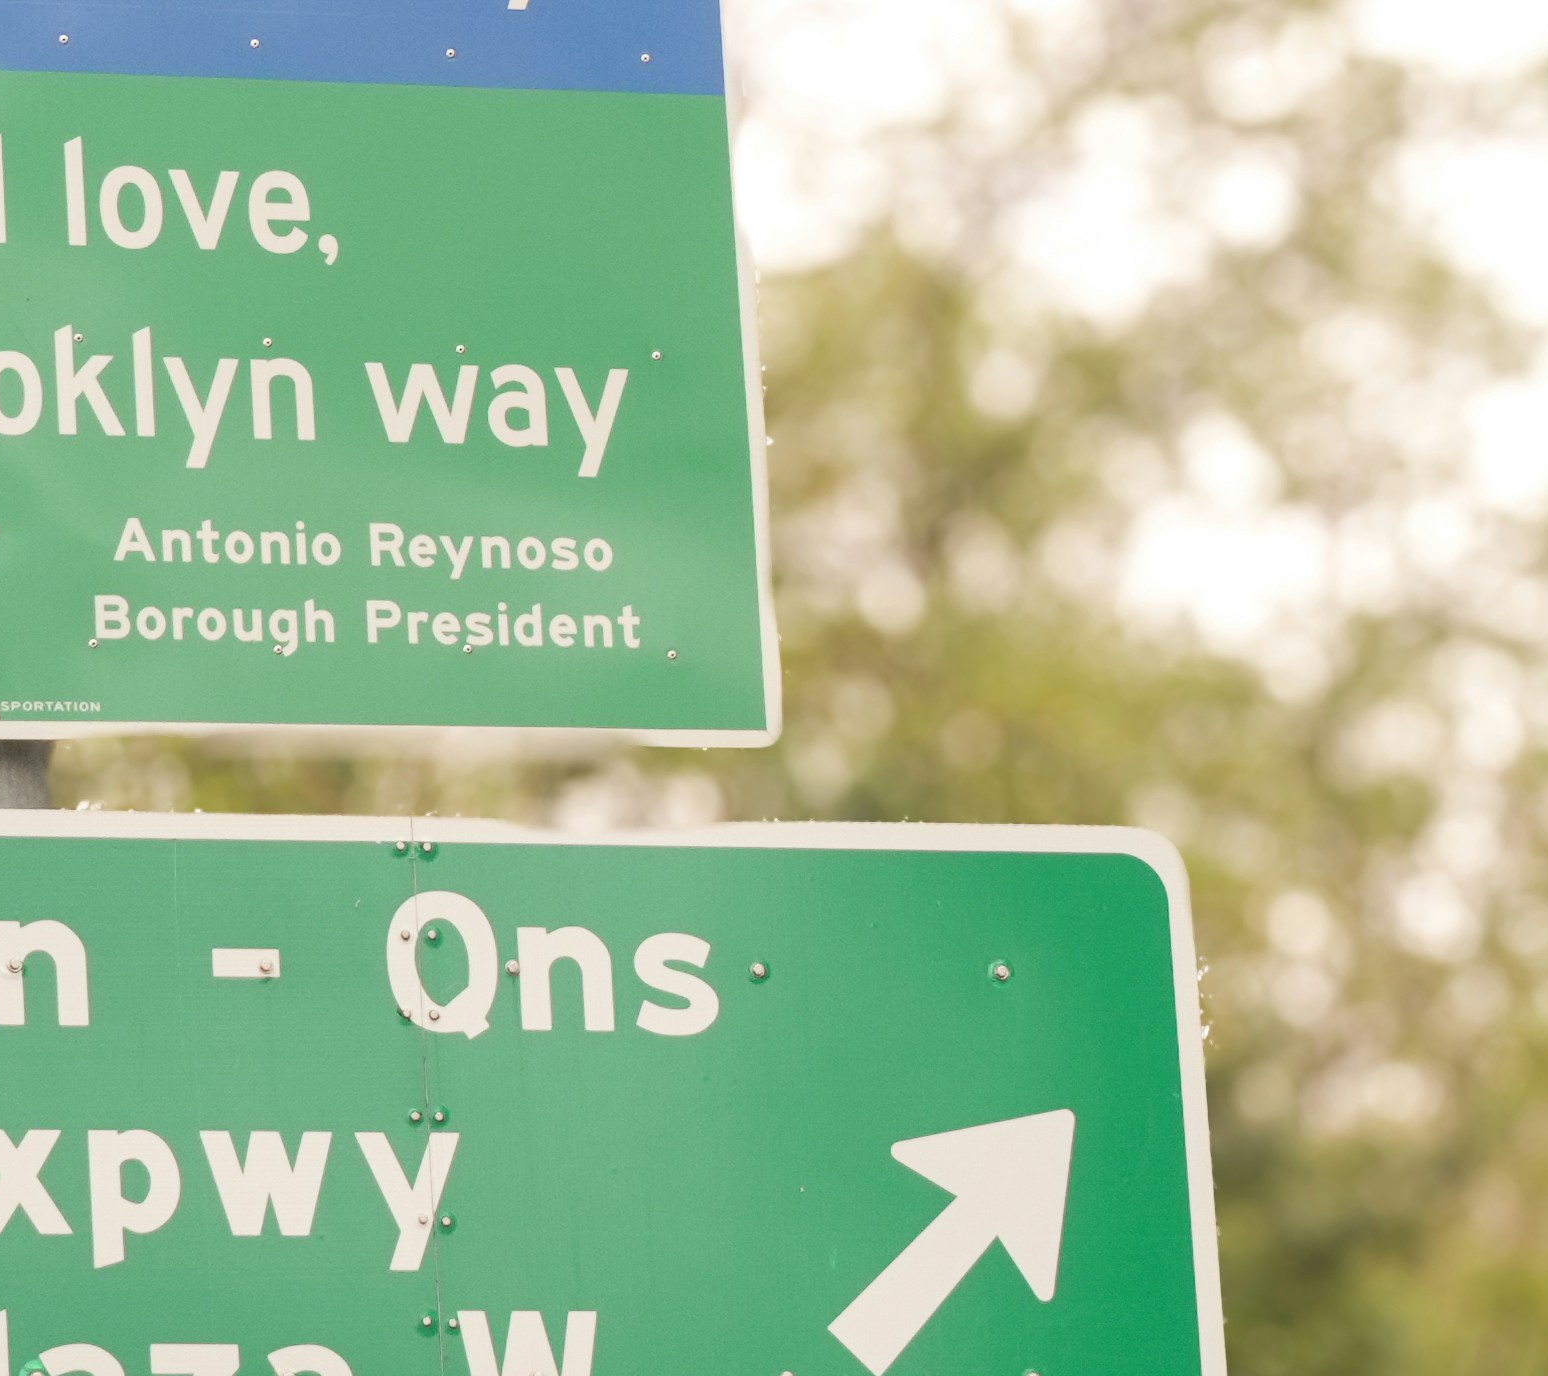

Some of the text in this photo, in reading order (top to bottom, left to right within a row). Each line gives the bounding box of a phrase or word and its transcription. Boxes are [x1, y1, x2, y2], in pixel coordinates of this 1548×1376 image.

[64, 136, 338, 265] love,
[365, 362, 628, 477] way
[114, 518, 613, 579] Antonio Reynoso
[89, 595, 640, 656] Borough President
[387, 891, 719, 1039] Qns
